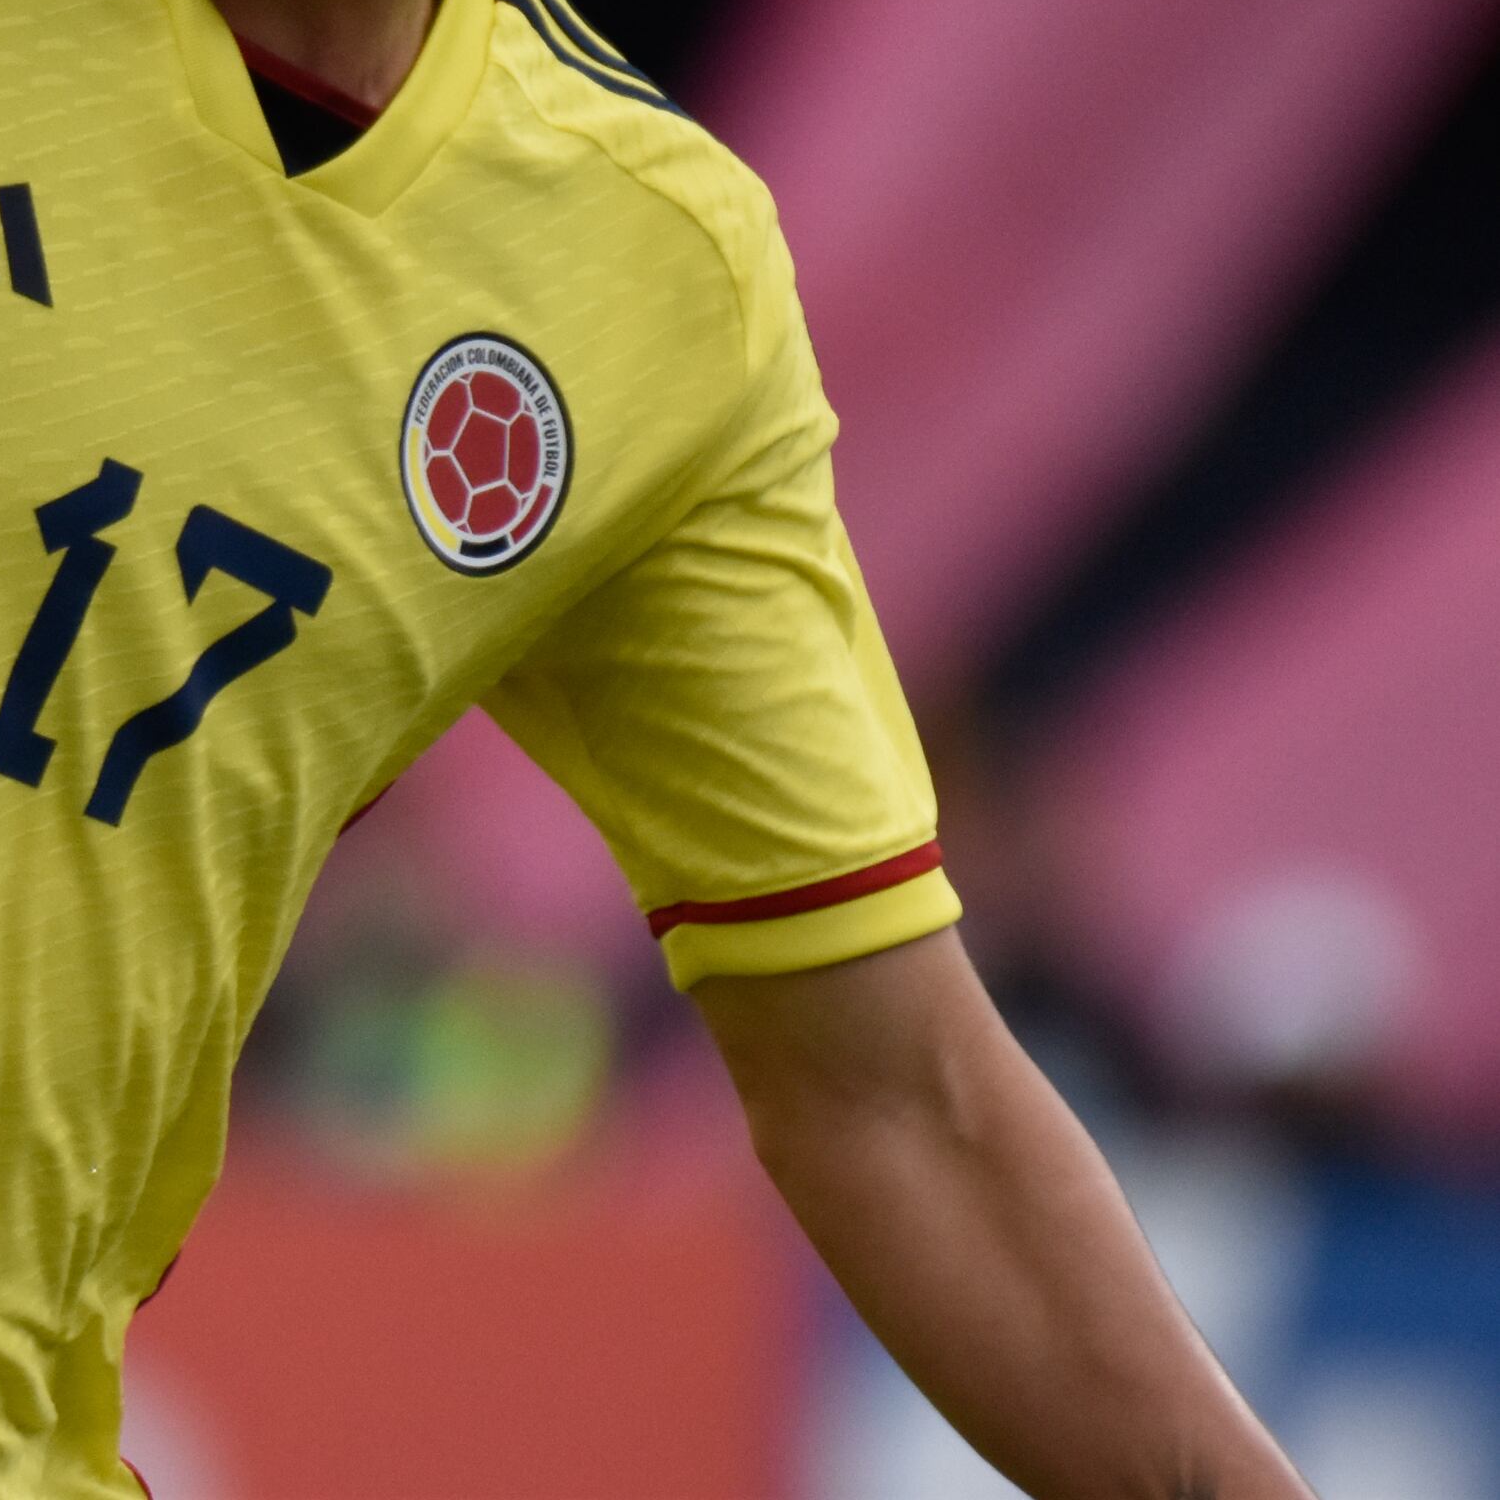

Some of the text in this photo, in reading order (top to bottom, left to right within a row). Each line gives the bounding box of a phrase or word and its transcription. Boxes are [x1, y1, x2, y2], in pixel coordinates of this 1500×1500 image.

[415, 348, 559, 478] FEDERACION COLOMBIANA DE FUTBOL
